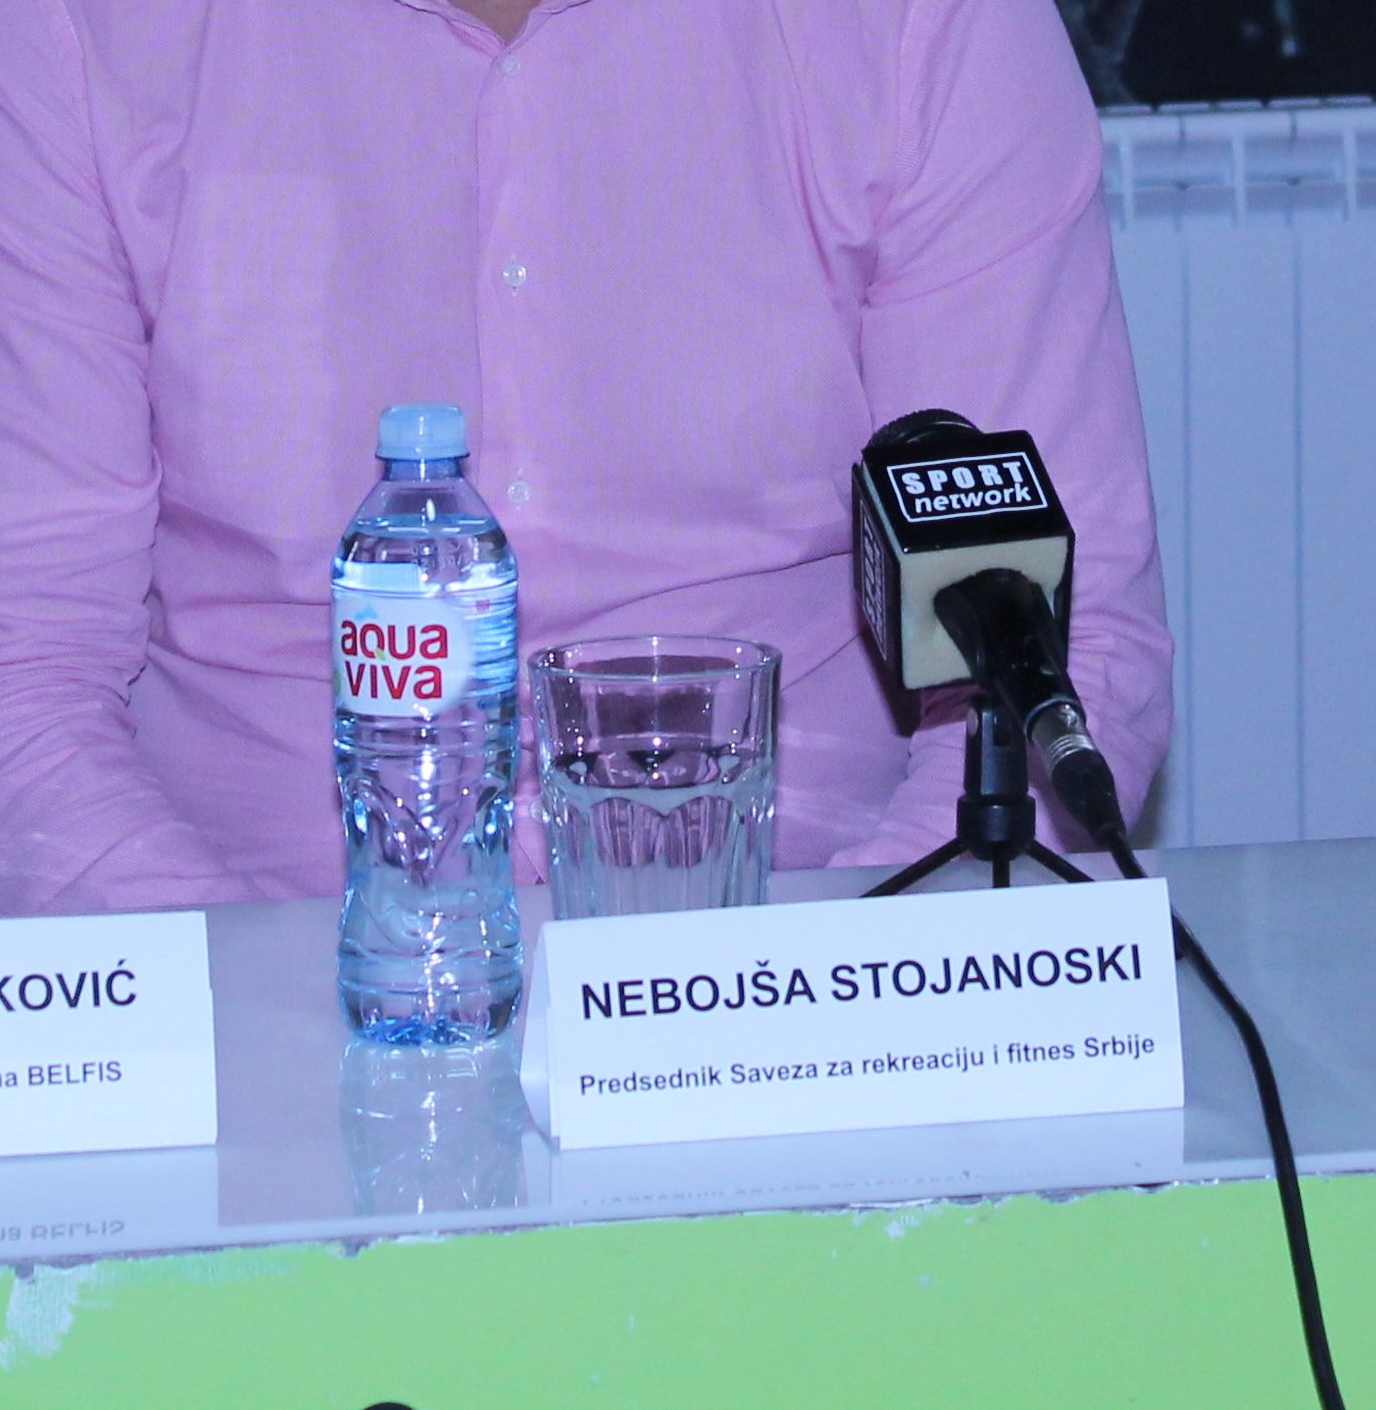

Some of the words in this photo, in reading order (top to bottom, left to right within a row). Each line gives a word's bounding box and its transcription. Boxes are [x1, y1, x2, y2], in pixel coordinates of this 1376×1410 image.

[902, 461, 1024, 495] SPORT
[915, 483, 1032, 513] network
[341, 620, 449, 660] aqua
[345, 660, 443, 700] viva
[581, 959, 817, 1020] NEBOJŠA
[830, 944, 1142, 1002] STOJANOSKI
[27, 1060, 122, 1087] BELFIS
[579, 1065, 722, 1096] Predsednik
[730, 1062, 819, 1085] Saveza
[826, 1060, 854, 1078] za
[861, 1046, 985, 1075] rekreaciju
[993, 1044, 999, 1065] i
[1006, 1042, 1076, 1064] fitnes
[1083, 1033, 1155, 1060] Srbije
